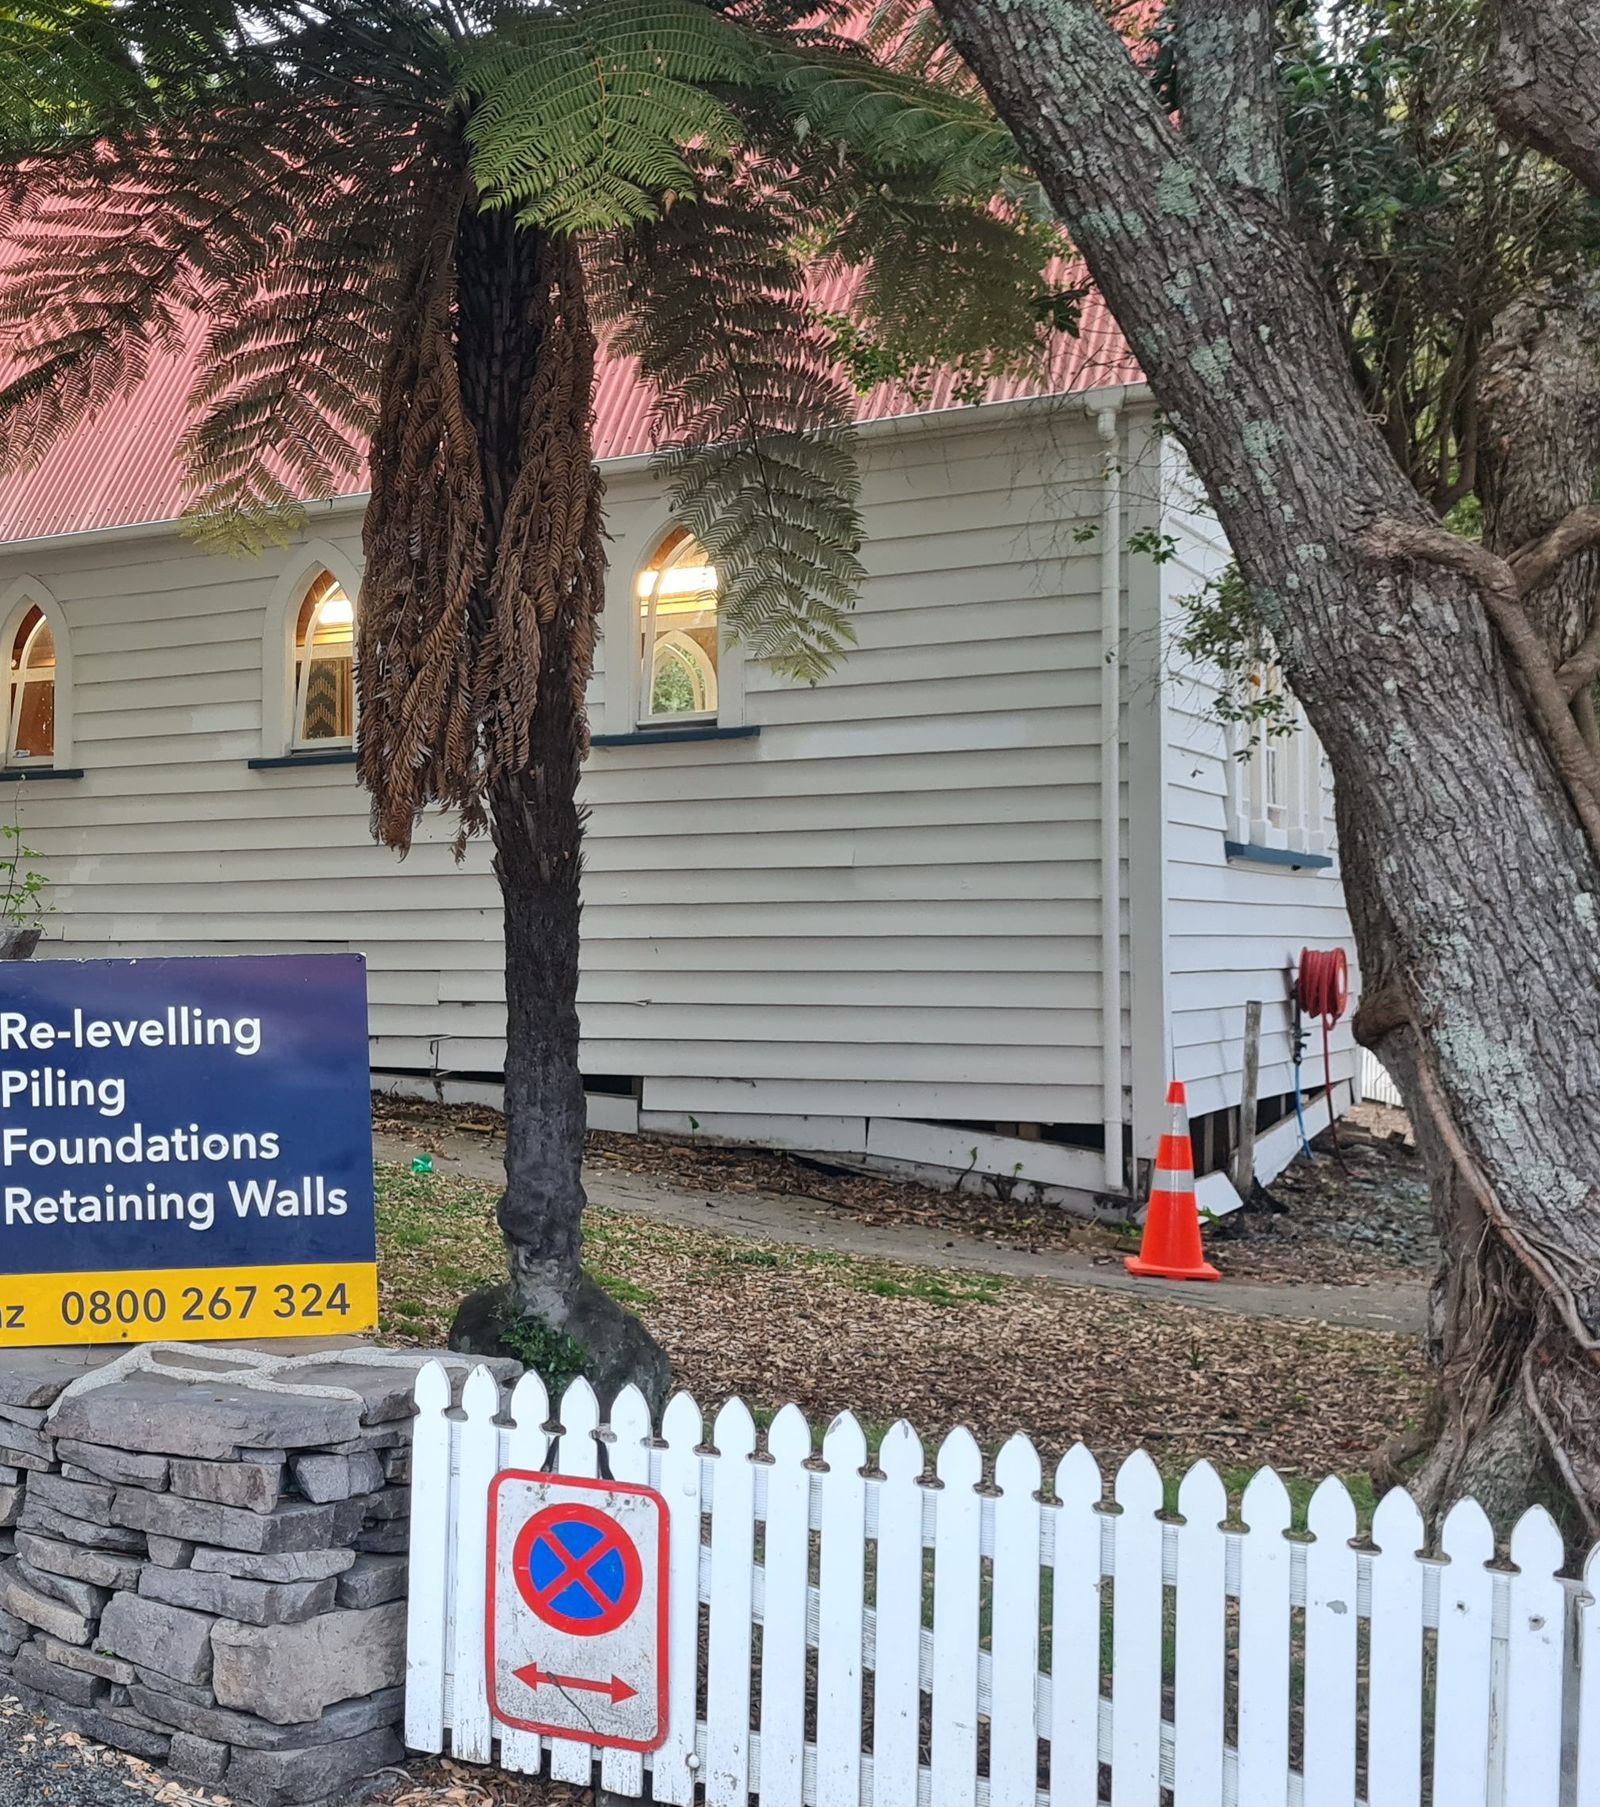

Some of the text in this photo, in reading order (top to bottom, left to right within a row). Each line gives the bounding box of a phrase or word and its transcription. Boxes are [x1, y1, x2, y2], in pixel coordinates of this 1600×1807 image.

[0, 1006, 261, 1055] Re-levelling
[1, 1067, 126, 1117] Piling
[3, 1123, 280, 1166] Foundations
[5, 1176, 348, 1231] Retaining Walls
[61, 1288, 167, 1327] 0800
[181, 1286, 258, 1322] 267
[273, 1282, 351, 1319] 324
